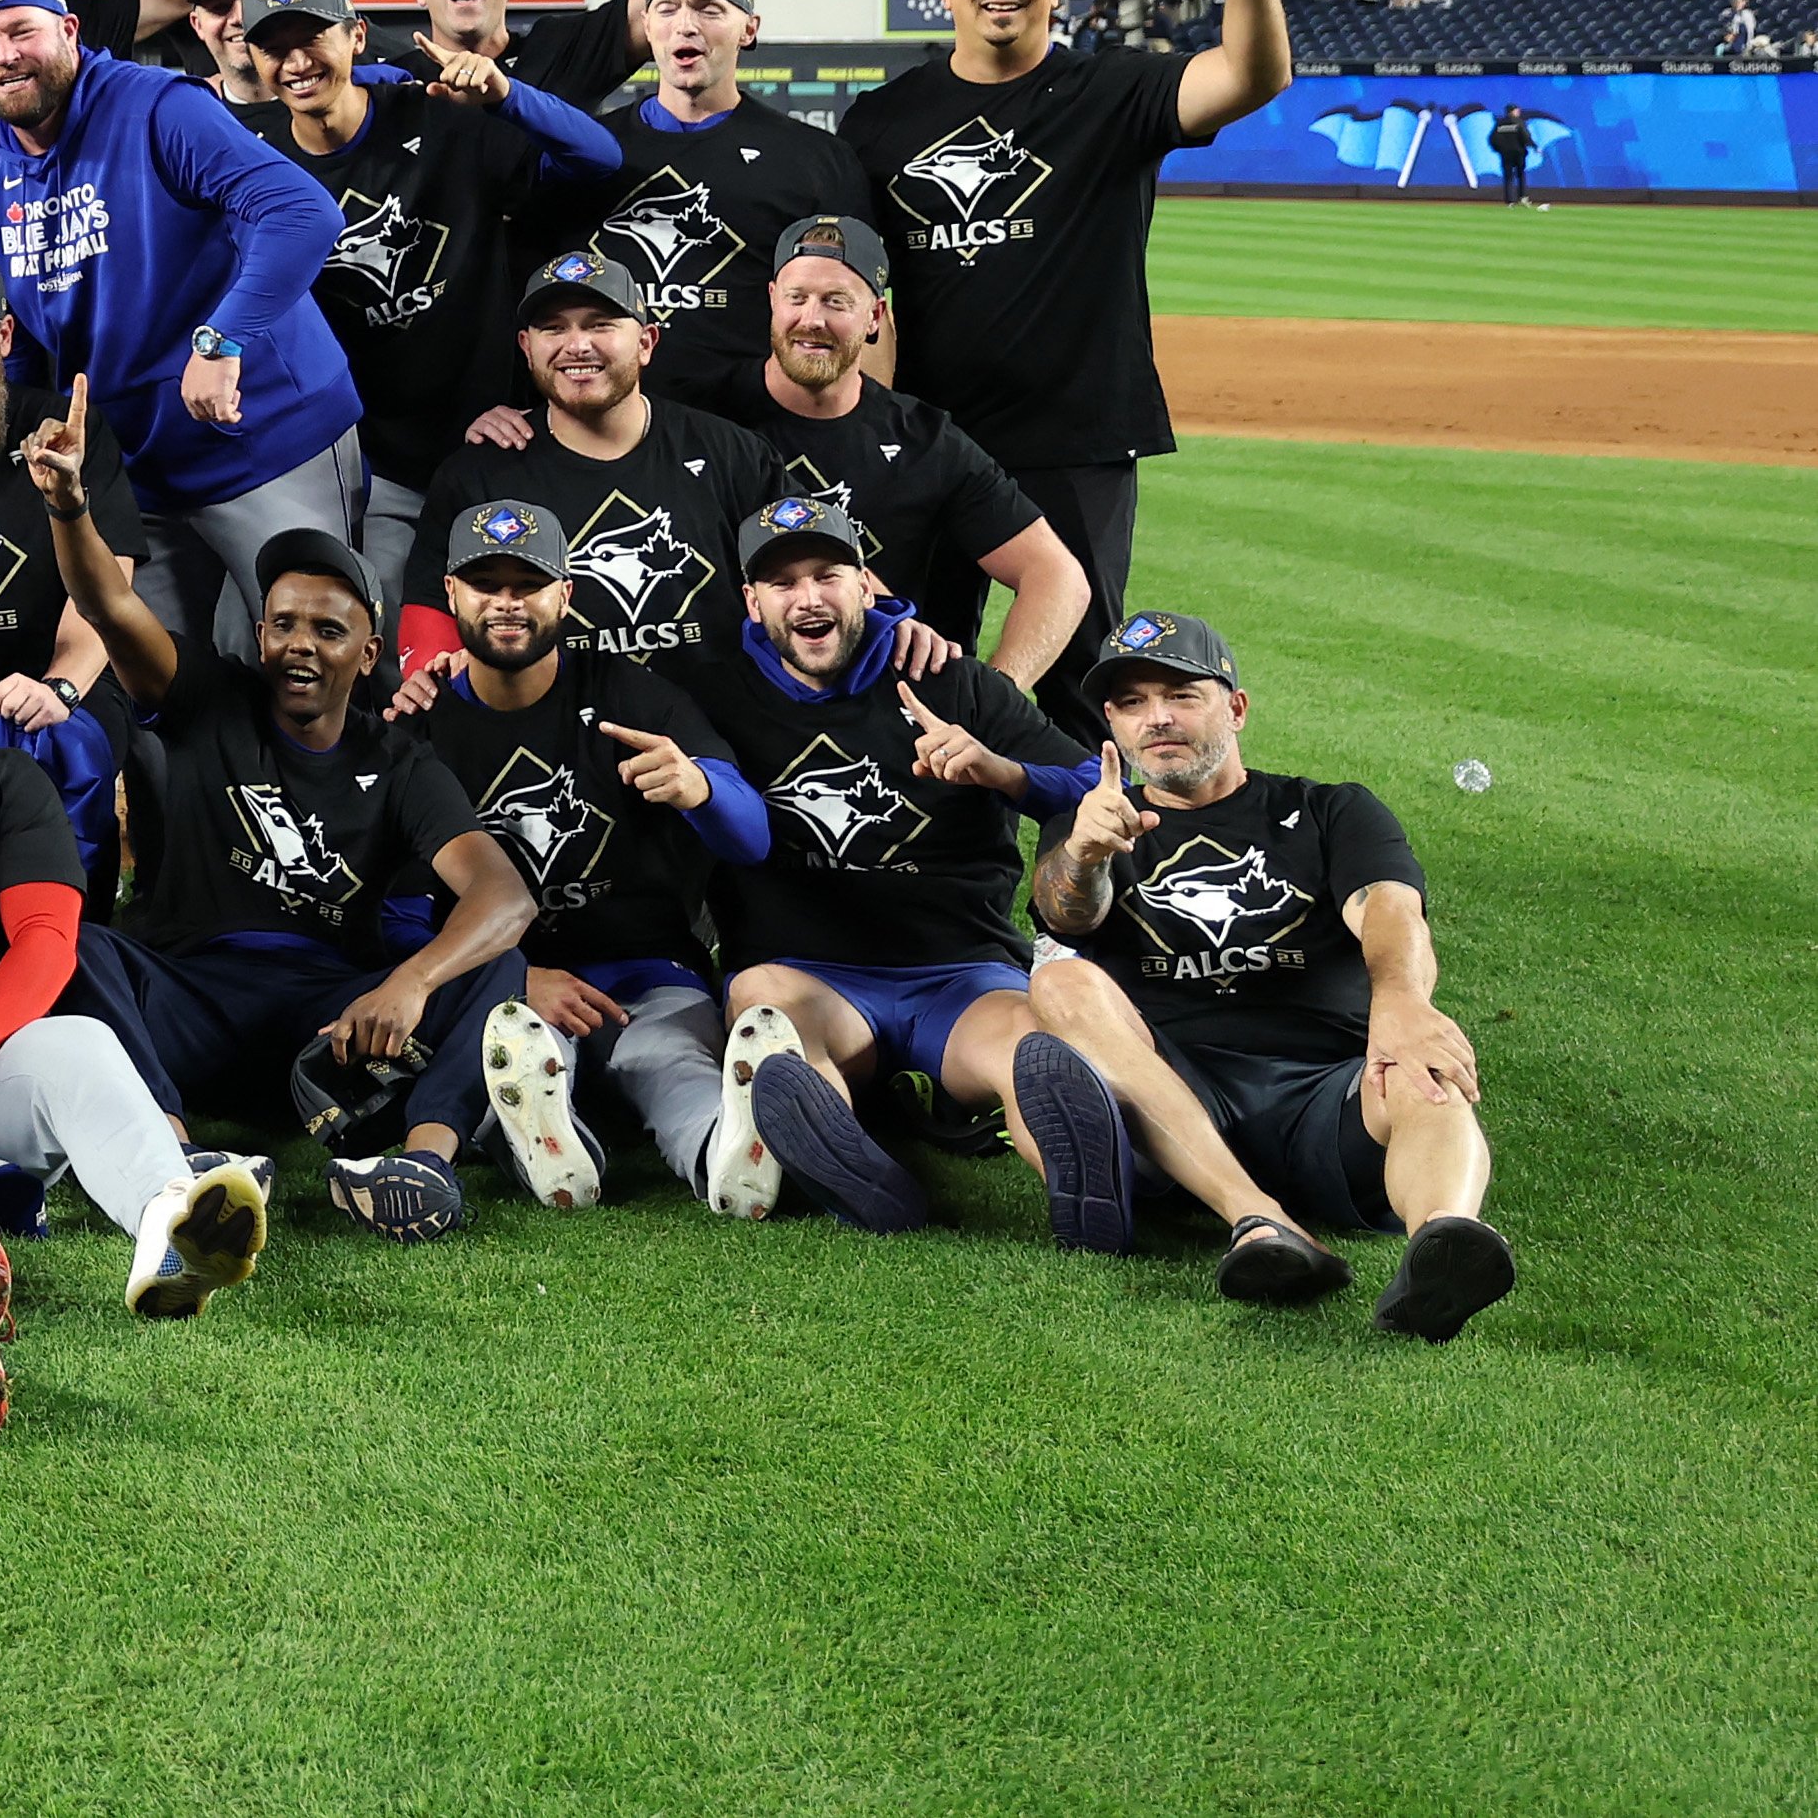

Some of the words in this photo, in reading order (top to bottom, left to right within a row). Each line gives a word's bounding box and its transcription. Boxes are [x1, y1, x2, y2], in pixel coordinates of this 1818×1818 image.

[55, 199, 110, 244] JAYS
[930, 220, 1006, 250] ALCS
[1010, 220, 1035, 238] 25
[365, 286, 433, 327] ALCS
[705, 289, 727, 306] 25
[597, 623, 681, 654] ALCS
[683, 624, 703, 644] 25
[319, 903, 344, 926] 25
[1142, 957, 1168, 976] 20
[1172, 947, 1272, 980] ALCS
[1276, 950, 1305, 967] 25
